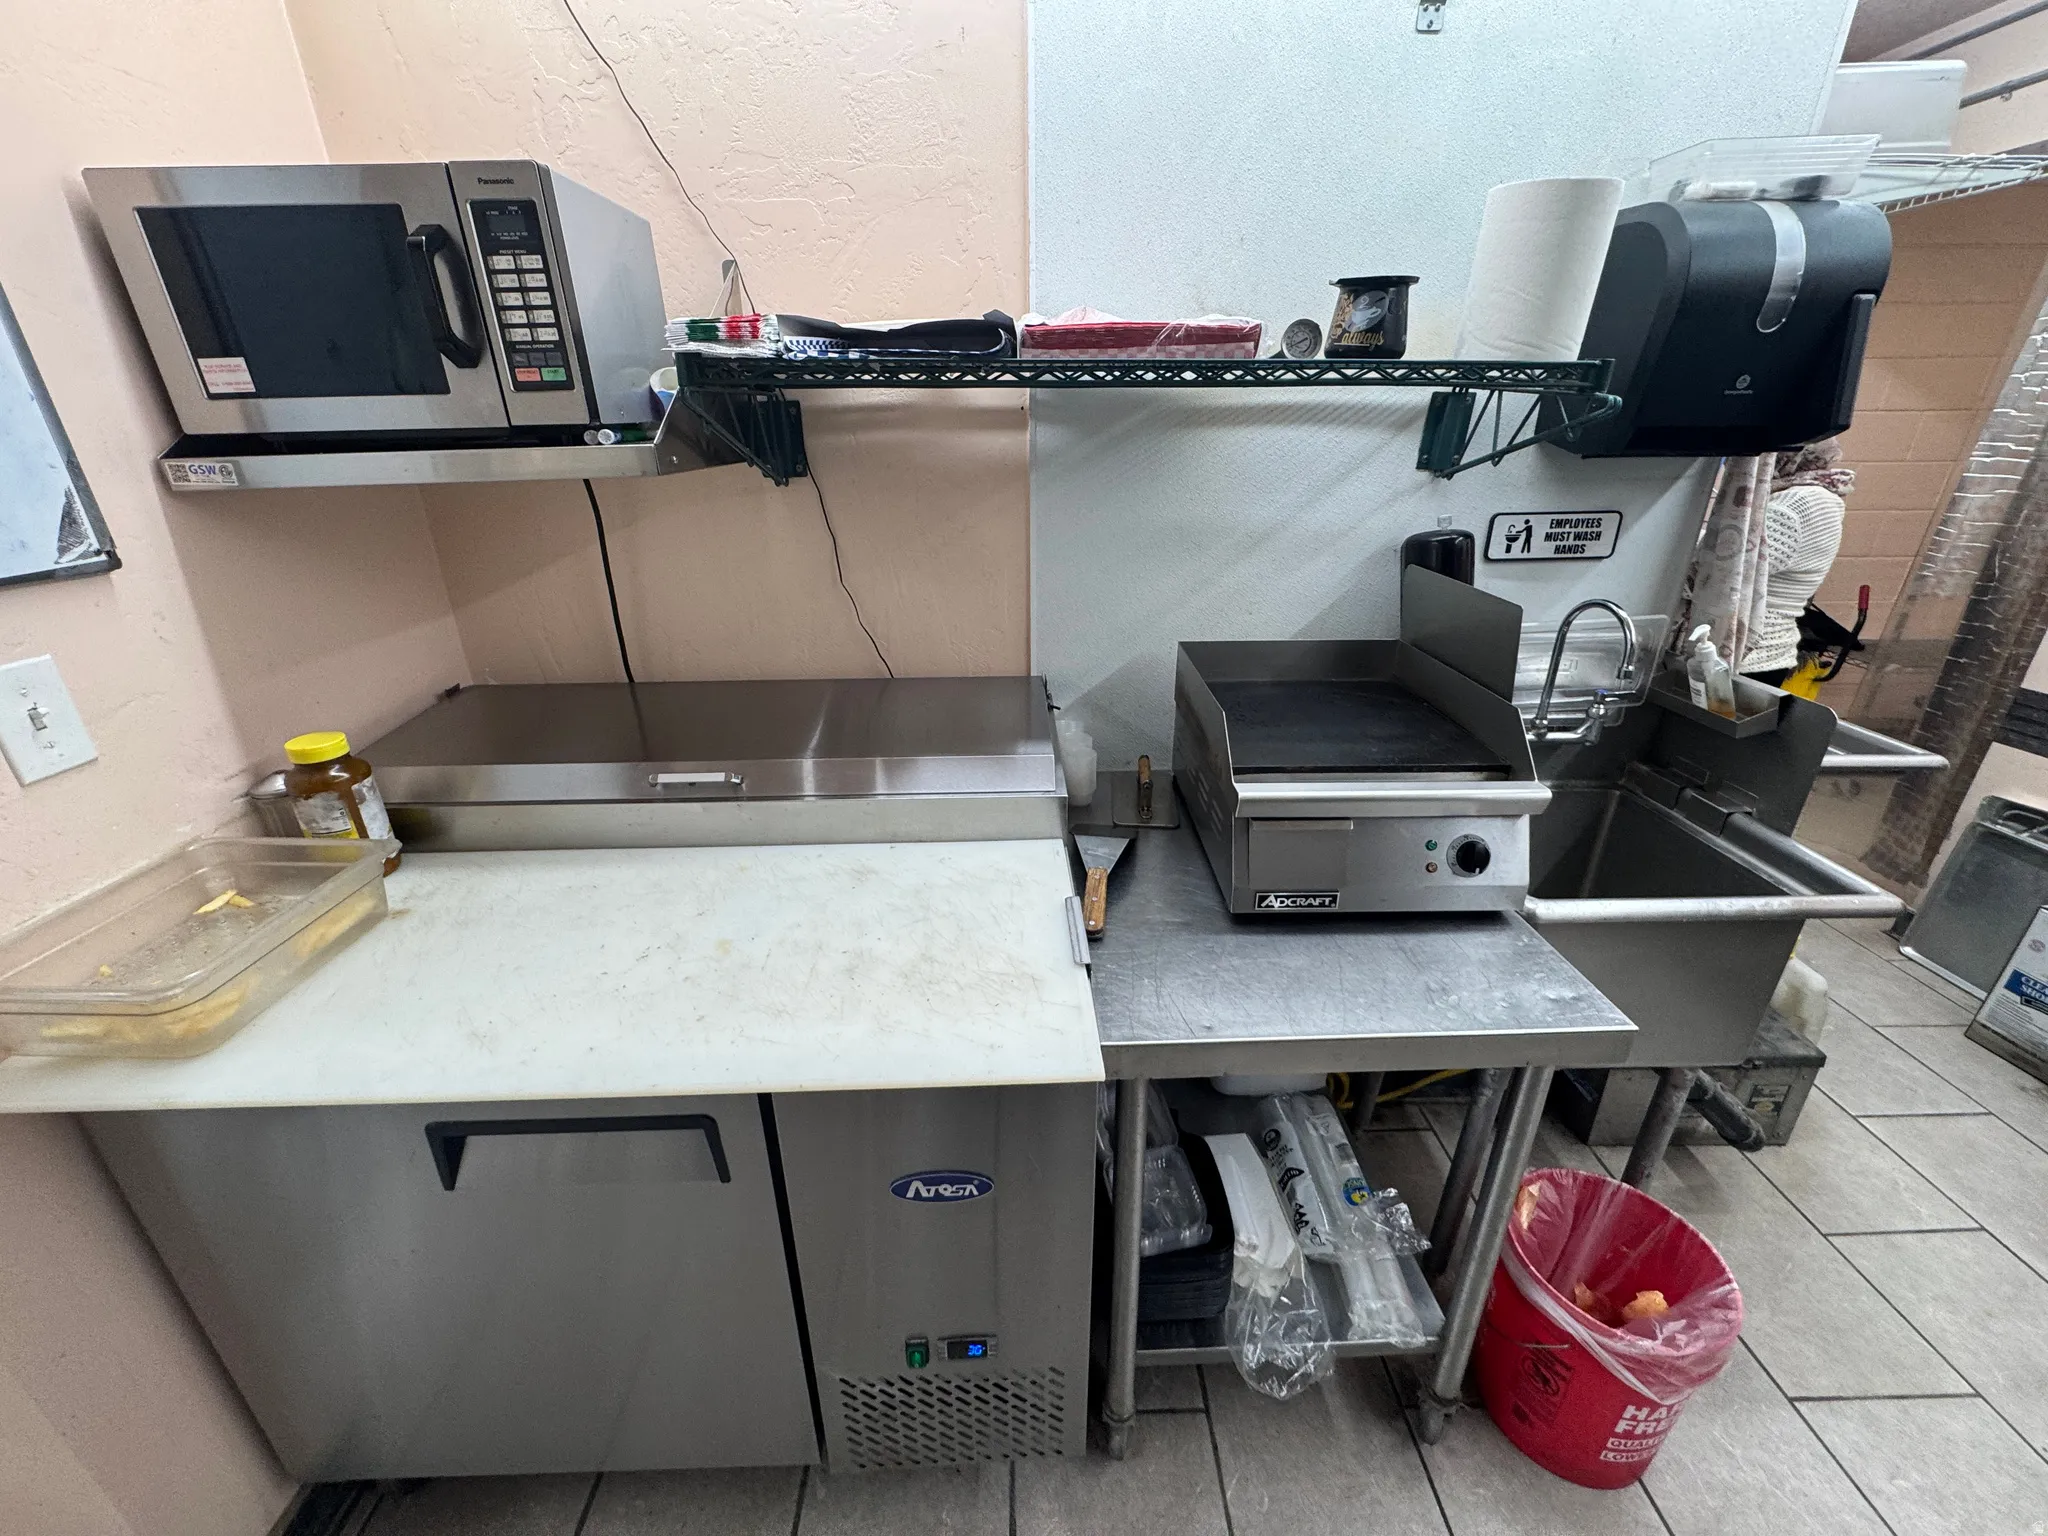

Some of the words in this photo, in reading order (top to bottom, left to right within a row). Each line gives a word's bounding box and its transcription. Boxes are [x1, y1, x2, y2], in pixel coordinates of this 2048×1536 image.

[477, 177, 515, 185] Panasonic
[1341, 330, 1385, 351] always
[188, 464, 217, 475] GSW
[1549, 517, 1603, 529] EMPLOYEES
[1544, 531, 1572, 542] MUST
[1573, 530, 1603, 541] WASH
[1553, 544, 1587, 555] HANDS
[1260, 895, 1332, 908] ADCRAFT
[905, 1180, 979, 1198] ATOSA
